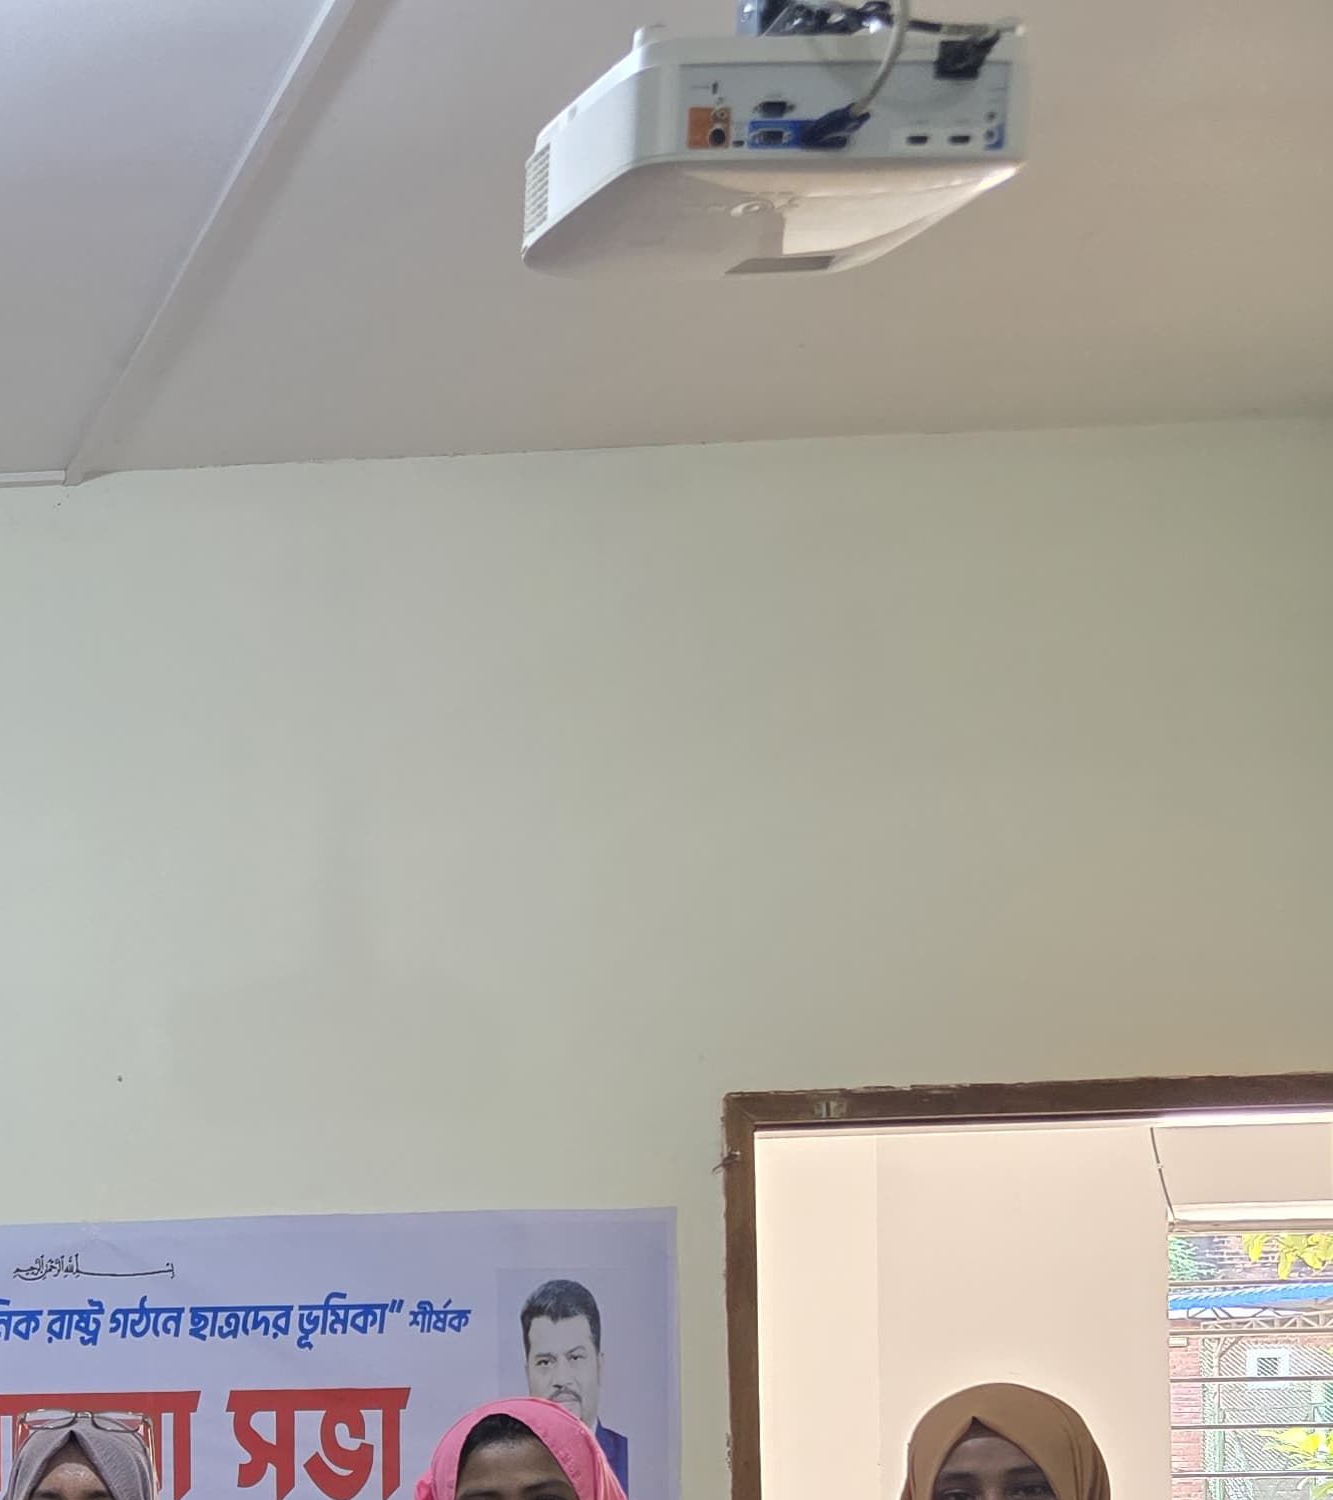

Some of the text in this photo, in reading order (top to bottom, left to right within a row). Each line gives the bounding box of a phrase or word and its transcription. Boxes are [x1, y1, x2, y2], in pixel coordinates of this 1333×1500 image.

[46, 1299, 105, 1347] রাষ্ট্র
[109, 1296, 184, 1340] গঠনে
[189, 1304, 293, 1342] ছাত্রদের
[409, 1299, 472, 1333] শীর্ষক
